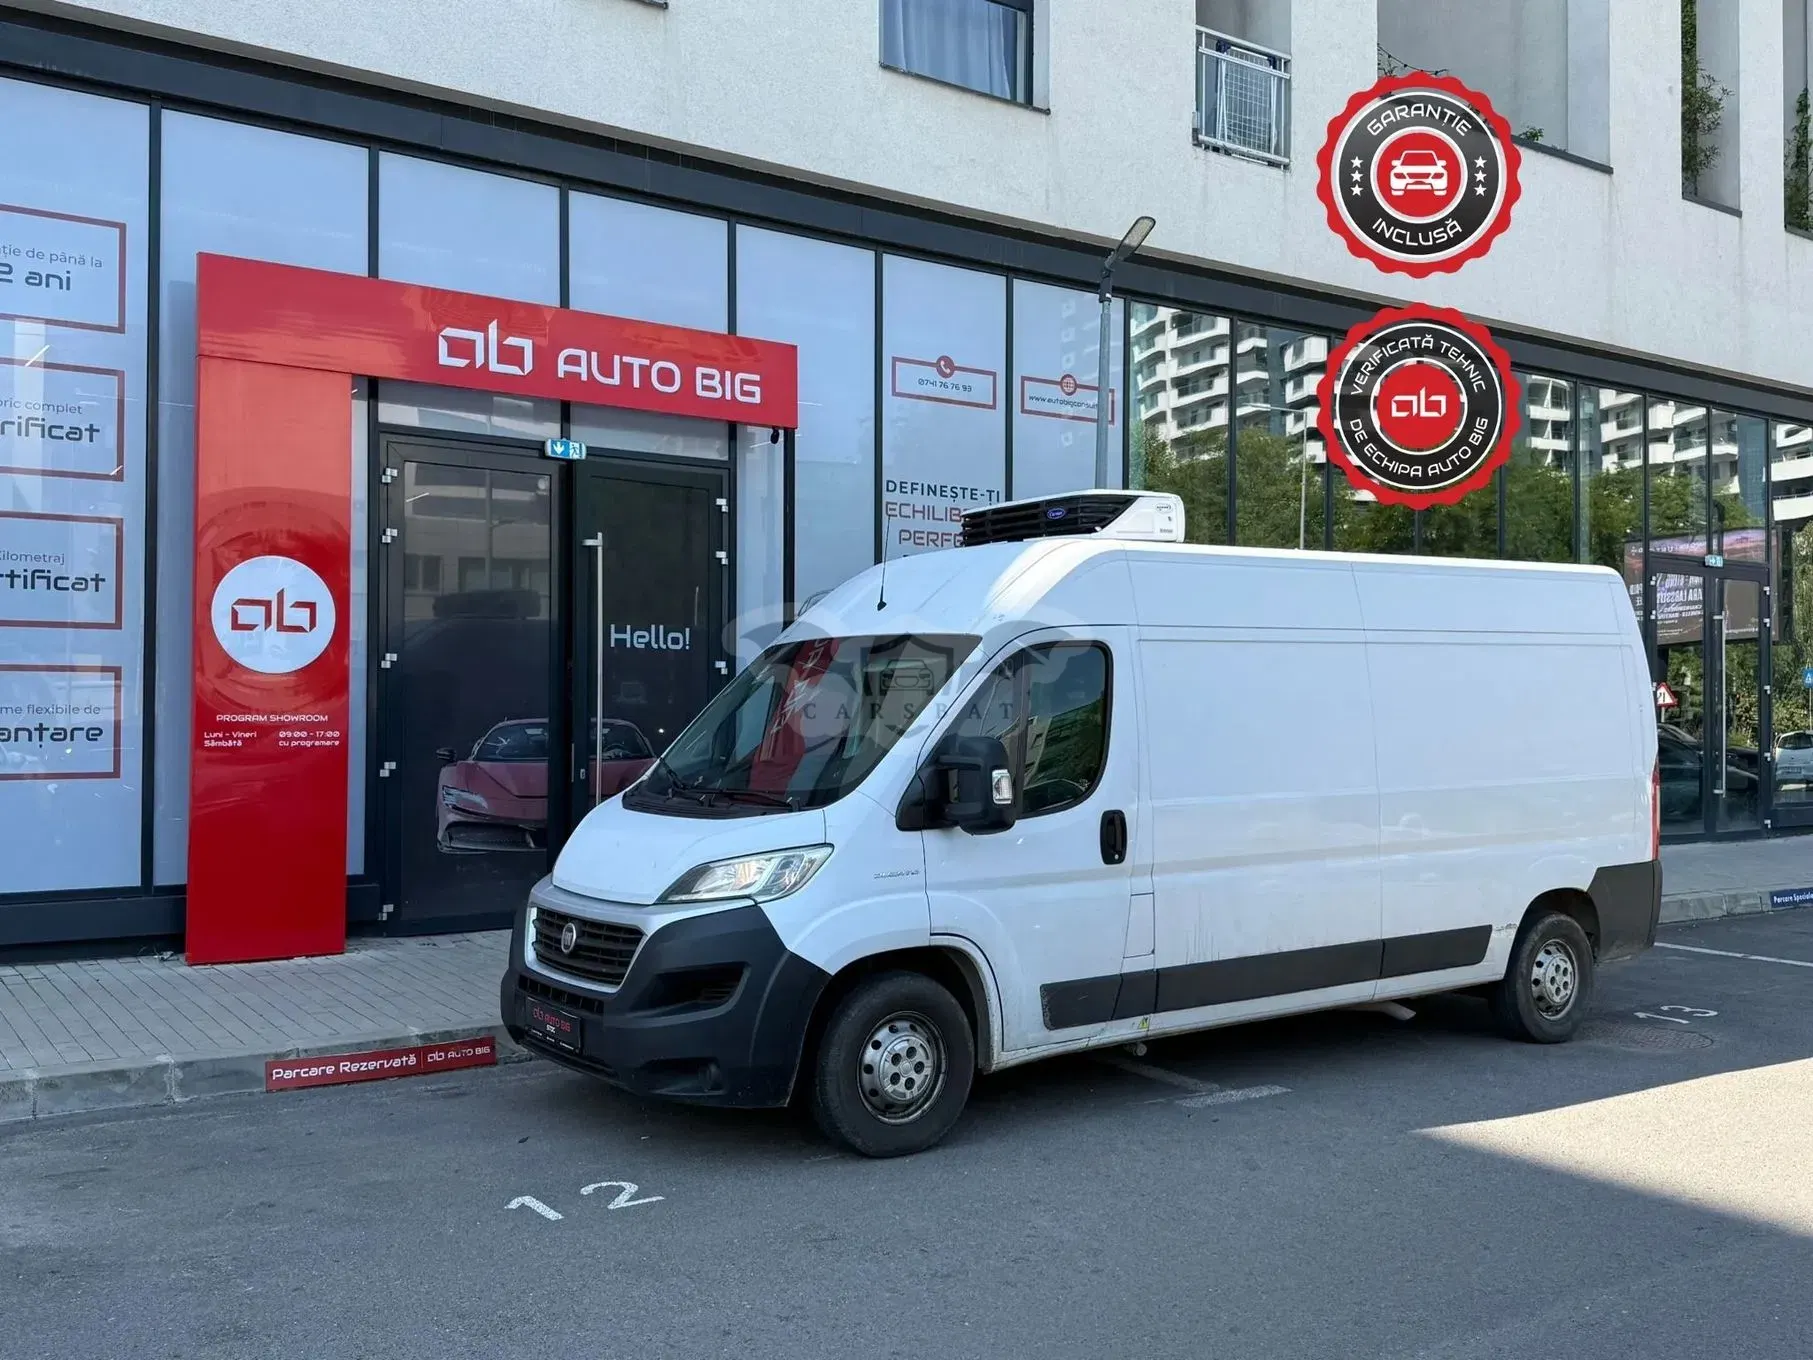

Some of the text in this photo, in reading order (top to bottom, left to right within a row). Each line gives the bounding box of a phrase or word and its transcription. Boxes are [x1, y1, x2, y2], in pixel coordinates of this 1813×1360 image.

[0, 244, 103, 268] ție de până la
[24, 270, 71, 291] ani
[557, 348, 761, 404] AUTO BIG
[917, 378, 937, 388] 0741
[939, 381, 949, 390] 76
[950, 383, 961, 391] 76
[0, 398, 83, 415] ric complet
[0, 415, 100, 443] rificat
[885, 501, 970, 523] ECHILIB
[0, 550, 65, 565] ilometraj
[0, 568, 106, 592] tificat
[610, 624, 690, 650] Hello!
[27, 704, 80, 715] flexibile
[83, 704, 101, 715] de
[216, 714, 329, 722] PROGRAM SHOWROOM
[204, 731, 223, 739] Luni
[291, 739, 340, 748] programare
[1633, 1004, 1719, 1025] 13
[272, 1065, 335, 1081] Parcare
[339, 1053, 417, 1073] Rezervată
[447, 1048, 474, 1061] AUTO
[475, 1046, 490, 1055] BIG
